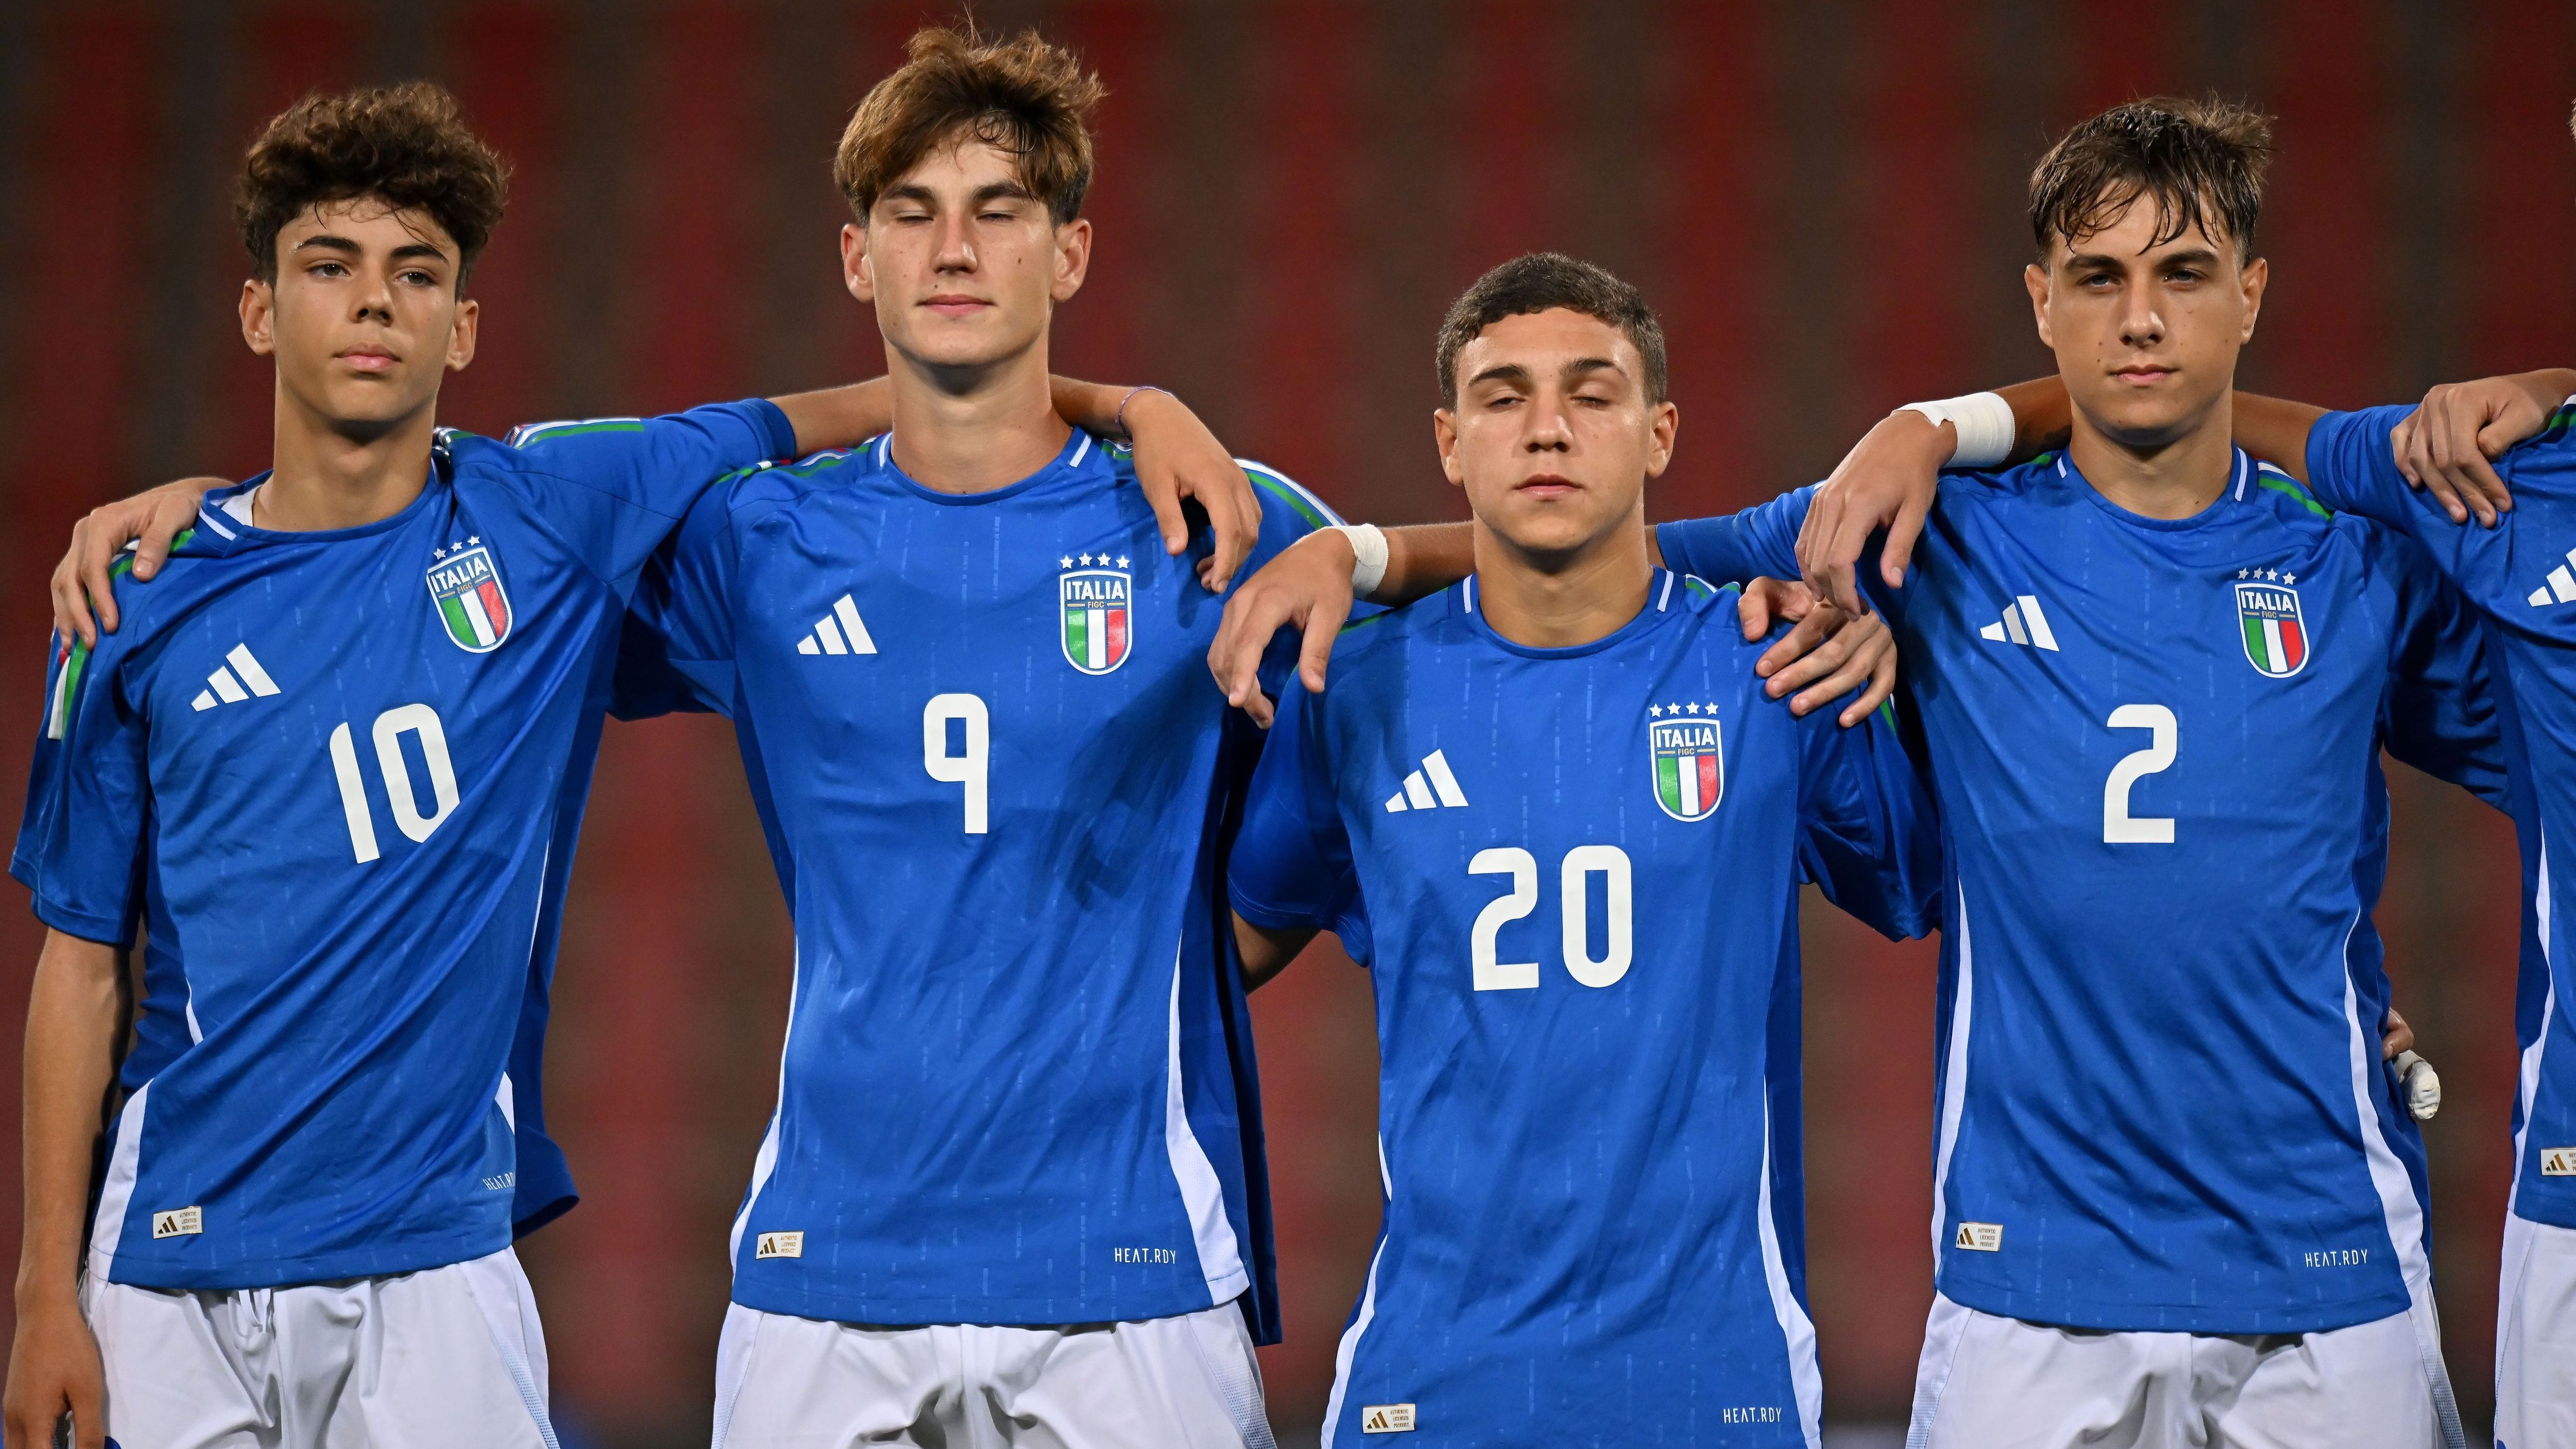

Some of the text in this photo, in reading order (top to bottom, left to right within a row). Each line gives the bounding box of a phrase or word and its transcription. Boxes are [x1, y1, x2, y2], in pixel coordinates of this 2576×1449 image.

[430, 557, 488, 593] ITALIA
[457, 582, 473, 593] FIGC
[1066, 581, 1125, 600] ITALIA
[2241, 591, 2294, 612] ITALIA
[2261, 610, 2277, 619] FIGC
[1656, 728, 1715, 748] ITALIA
[1678, 747, 1695, 756] FIGC
[924, 694, 989, 833] 9
[2104, 704, 2177, 843] 2
[330, 704, 460, 863] 10
[1468, 845, 1632, 991] 20
[1115, 1248, 1176, 1265] HEAT.RDY
[2305, 1249, 2368, 1267] HEAT.RDY
[1723, 1407, 1781, 1424] HEAT.RDY
